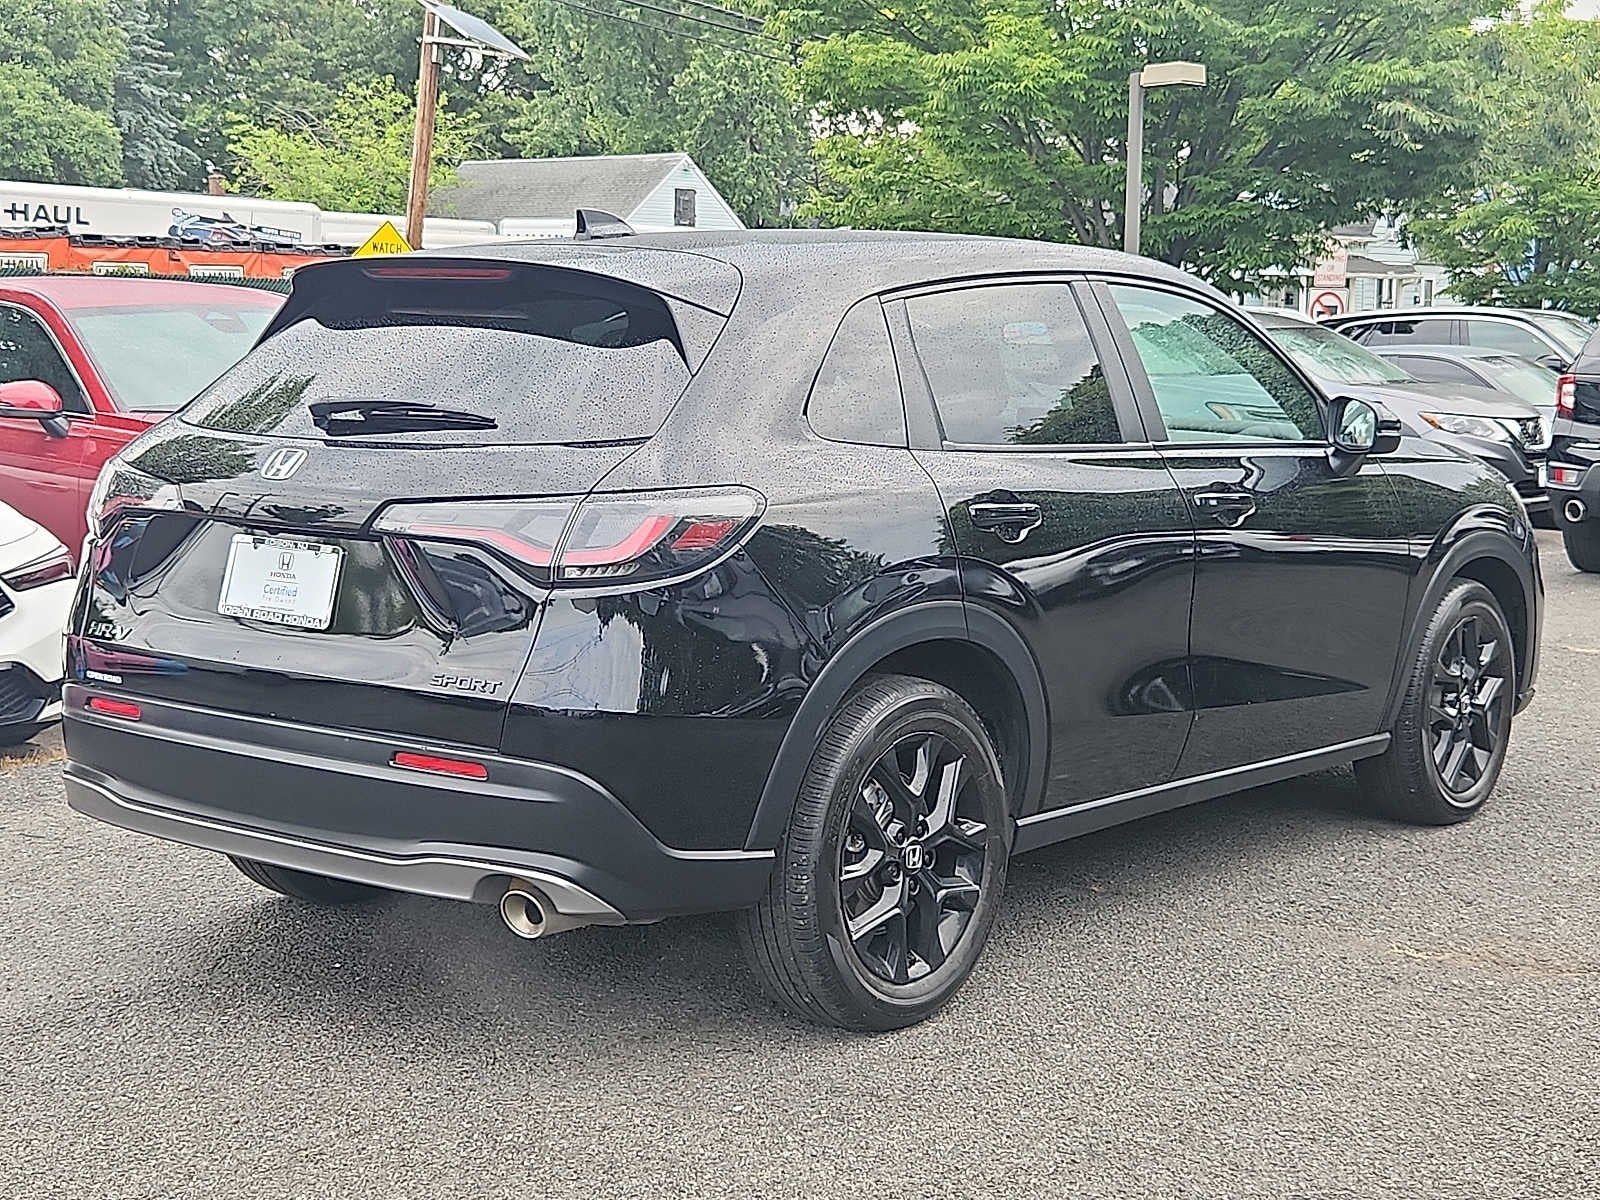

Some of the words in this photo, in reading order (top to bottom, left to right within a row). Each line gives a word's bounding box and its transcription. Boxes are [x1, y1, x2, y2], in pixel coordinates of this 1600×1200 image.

[372, 241, 402, 254] WATCH
[0, 258, 42, 271] -HAUL
[270, 571, 297, 580] HONDA
[263, 584, 298, 598] Certified
[224, 605, 251, 618] OPEN
[252, 609, 282, 623] ROAD
[283, 613, 324, 629] HONDA
[429, 673, 503, 695] SPORT
